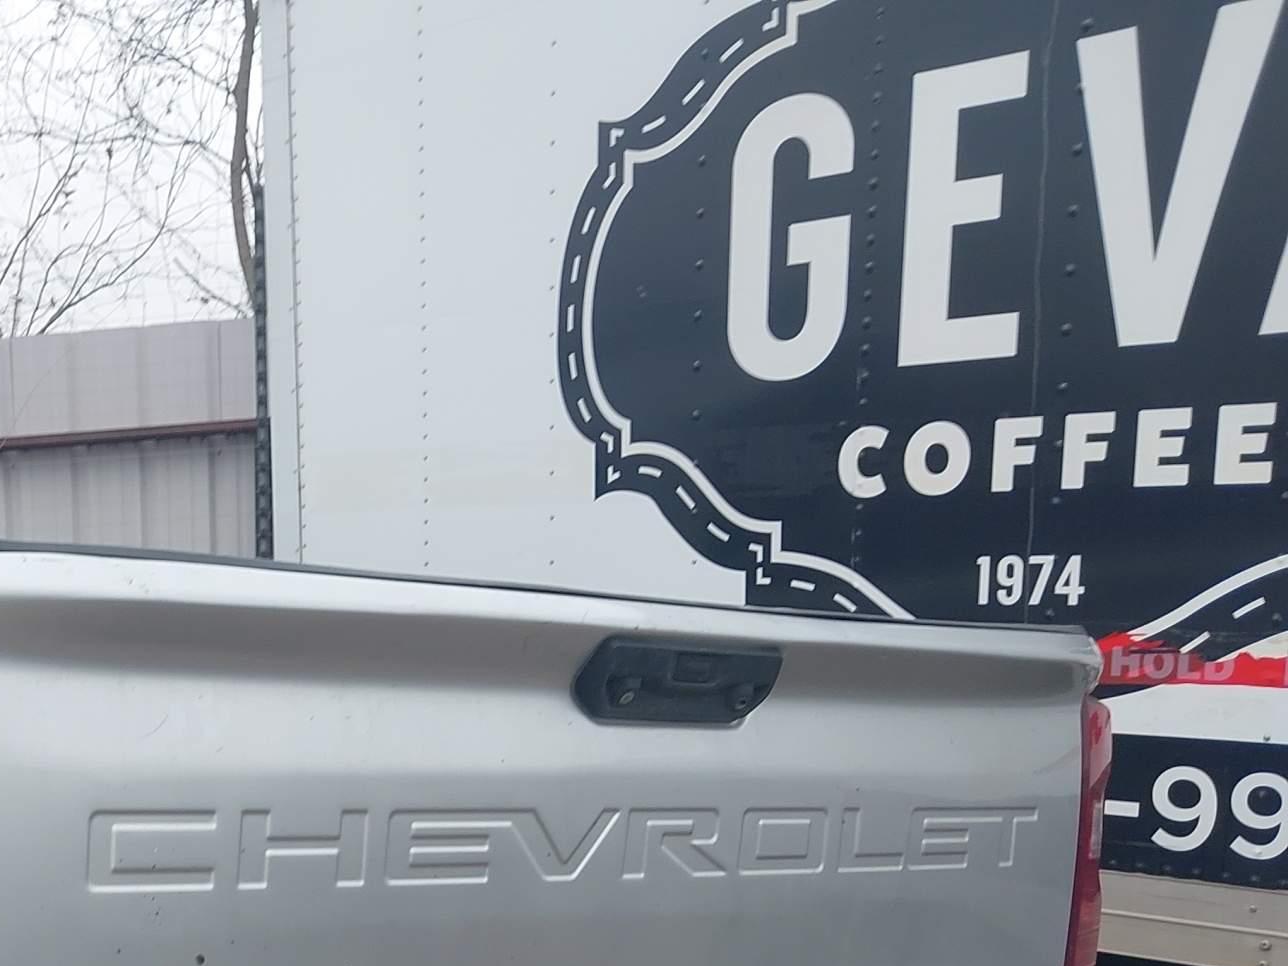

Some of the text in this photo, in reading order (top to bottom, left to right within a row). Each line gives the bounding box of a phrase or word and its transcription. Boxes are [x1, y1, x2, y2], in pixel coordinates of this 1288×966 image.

[727, 0, 1288, 381] GEV
[838, 403, 1278, 498] COFFEE
[976, 555, 1085, 606] 1974
[86, 808, 1039, 893] CHEVROLET
